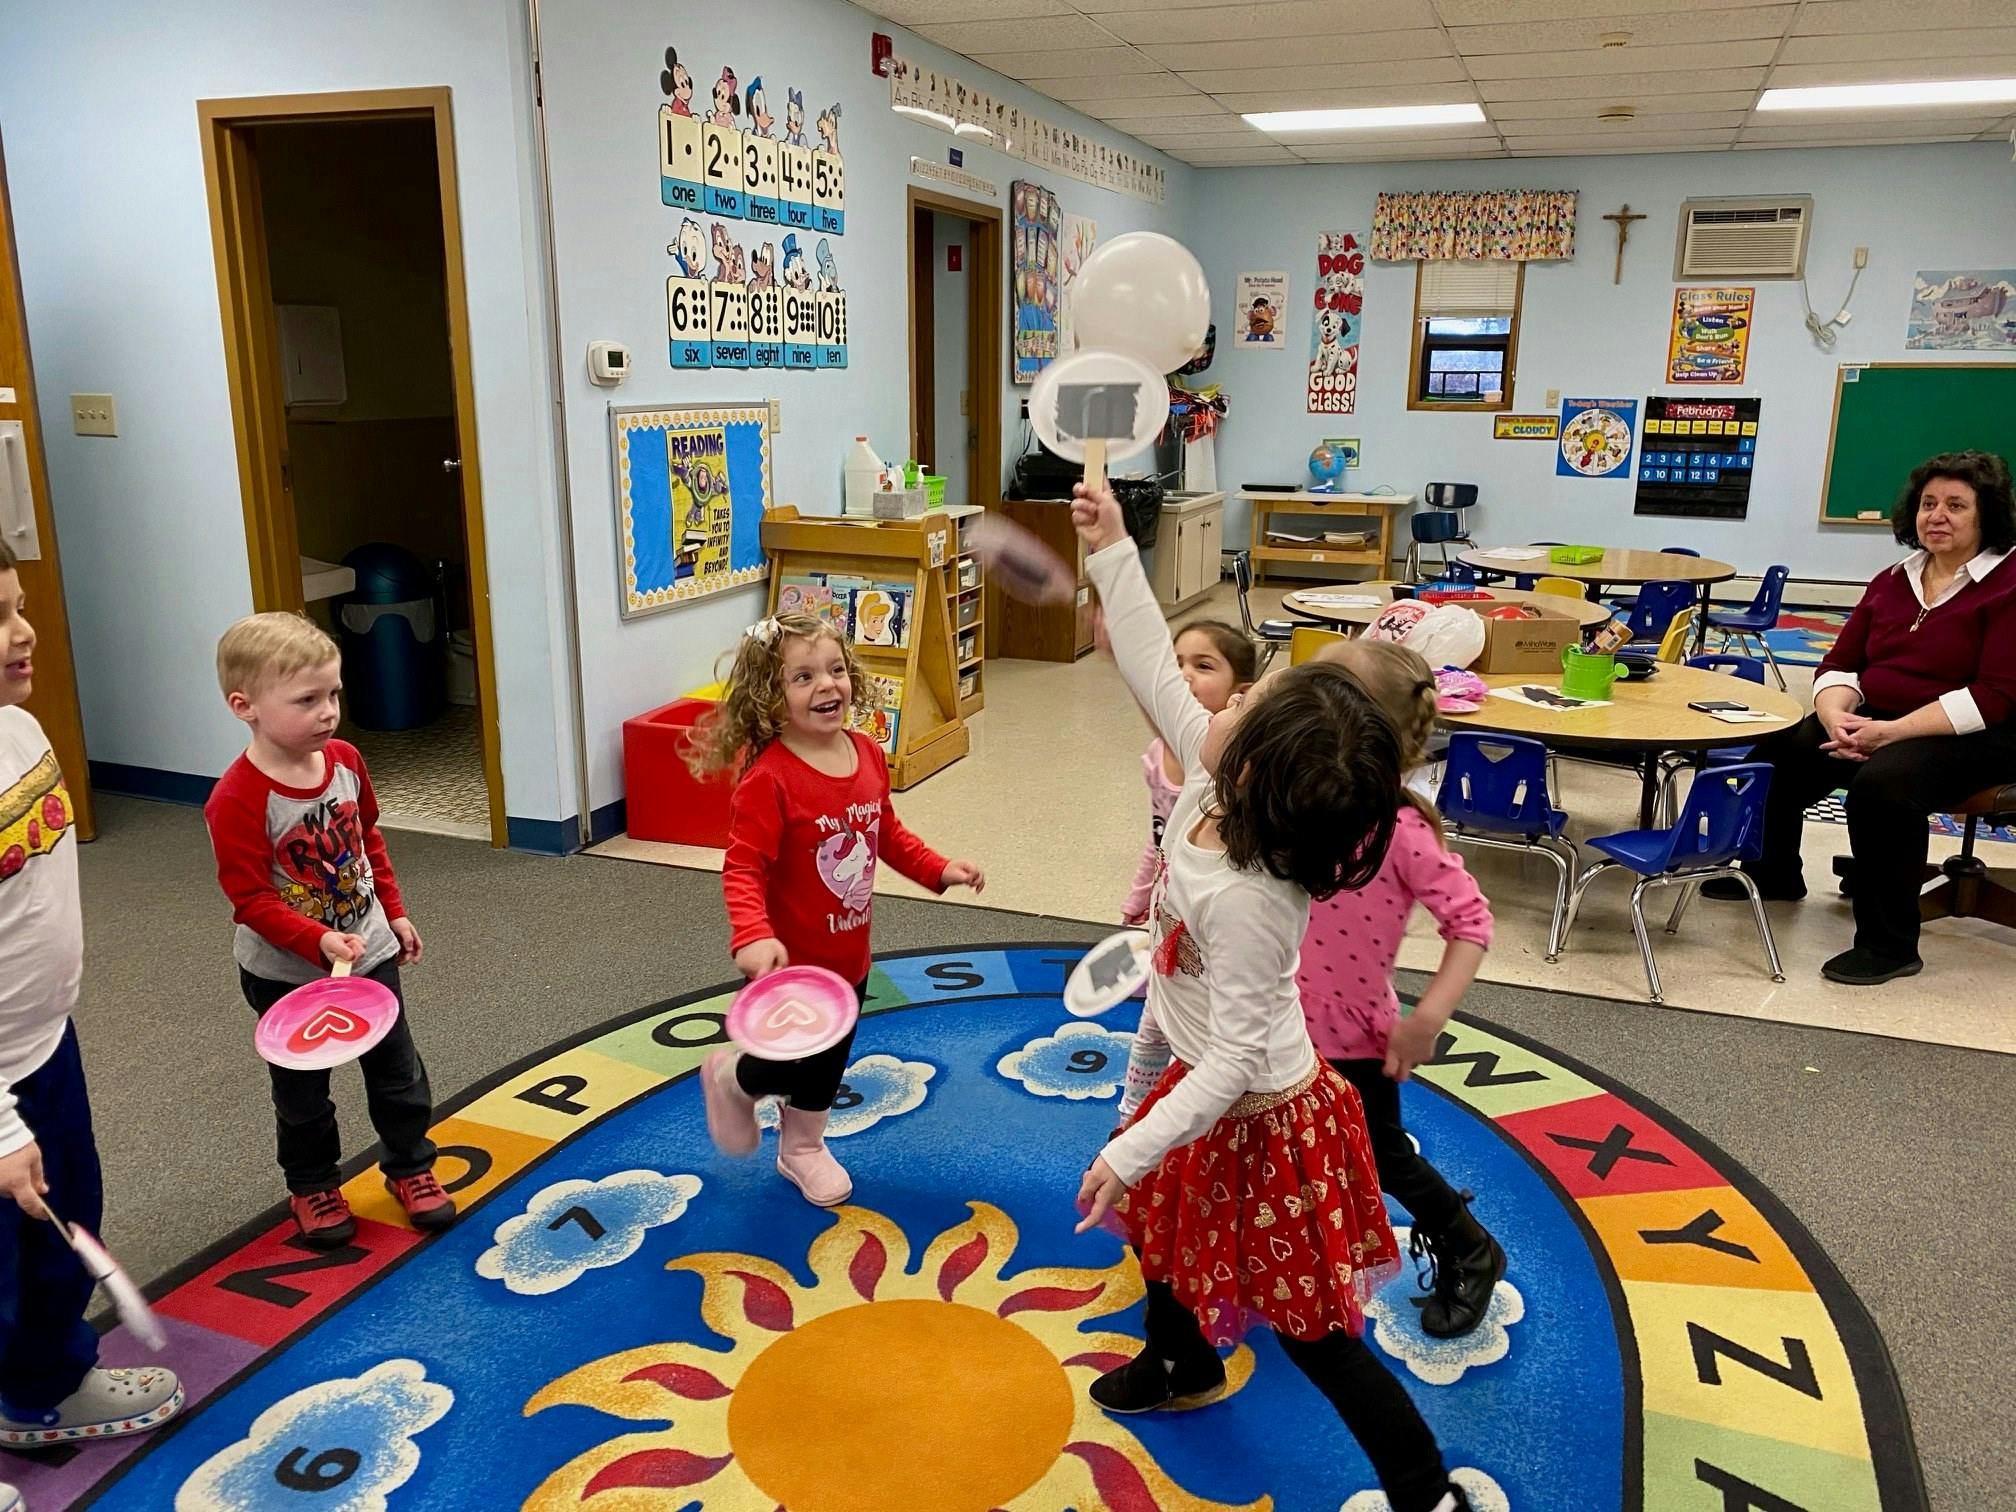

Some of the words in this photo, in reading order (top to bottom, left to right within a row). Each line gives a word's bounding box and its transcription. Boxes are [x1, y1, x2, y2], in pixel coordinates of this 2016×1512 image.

[666, 119, 673, 165] 1
[707, 133, 723, 178] 2
[745, 145, 760, 187] 3
[781, 150, 794, 192] 4
[816, 158, 828, 198] 5
[672, 185, 696, 203] one
[714, 189, 737, 210] two
[750, 199, 776, 220] three
[787, 206, 808, 225] four
[821, 210, 838, 230] five
[1343, 233, 1358, 252] A
[1317, 253, 1365, 277] DOG
[1314, 287, 1363, 316] GONE
[1679, 292, 1712, 301] Class
[1716, 291, 1751, 302] Rules
[672, 286, 688, 332] 6
[714, 290, 729, 332] 7
[750, 293, 764, 335] 8
[786, 295, 799, 336] 9
[817, 300, 834, 340] 10
[1702, 316, 1724, 324] Listen
[684, 341, 700, 363] six
[716, 345, 748, 361] seven
[756, 345, 779, 367] eight
[792, 345, 811, 364] nine
[826, 349, 841, 363] ten
[1309, 372, 1356, 392] GOOD
[1568, 400, 1597, 409] Today's
[1676, 404, 1724, 418] February
[1513, 426, 1553, 435] CLOUDY
[671, 433, 724, 460] READING
[1645, 454, 1652, 463] 2
[1660, 455, 1666, 463] 3
[1675, 455, 1682, 464] 4
[1694, 456, 1700, 464] 5
[1710, 456, 1716, 465] 6
[1726, 456, 1732, 465] 7
[1741, 457, 1748, 466] 8
[1644, 470, 1650, 479] 9
[1656, 470, 1666, 479] 10
[1674, 471, 1682, 479] 11
[1691, 471, 1700, 480] 12
[1706, 471, 1716, 480] 13
[713, 507, 730, 521] TAKES
[711, 521, 722, 534] YOU
[723, 520, 730, 531] TO
[706, 533, 730, 548] INFINITY
[719, 546, 729, 559] AND
[704, 557, 728, 575] BEYOND!
[303, 797, 344, 836] WE
[814, 814, 841, 833] My
[846, 798, 882, 824] Magical
[924, 962, 985, 991] S
[1066, 1050, 1108, 1074] 9
[1425, 1031, 1551, 1087] W
[513, 1074, 592, 1116] P
[1543, 1123, 1678, 1181] X
[548, 1205, 607, 1242] 7
[1638, 1208, 1761, 1265] Y
[1686, 1320, 1823, 1401] Z
[274, 1446, 362, 1494] 6
